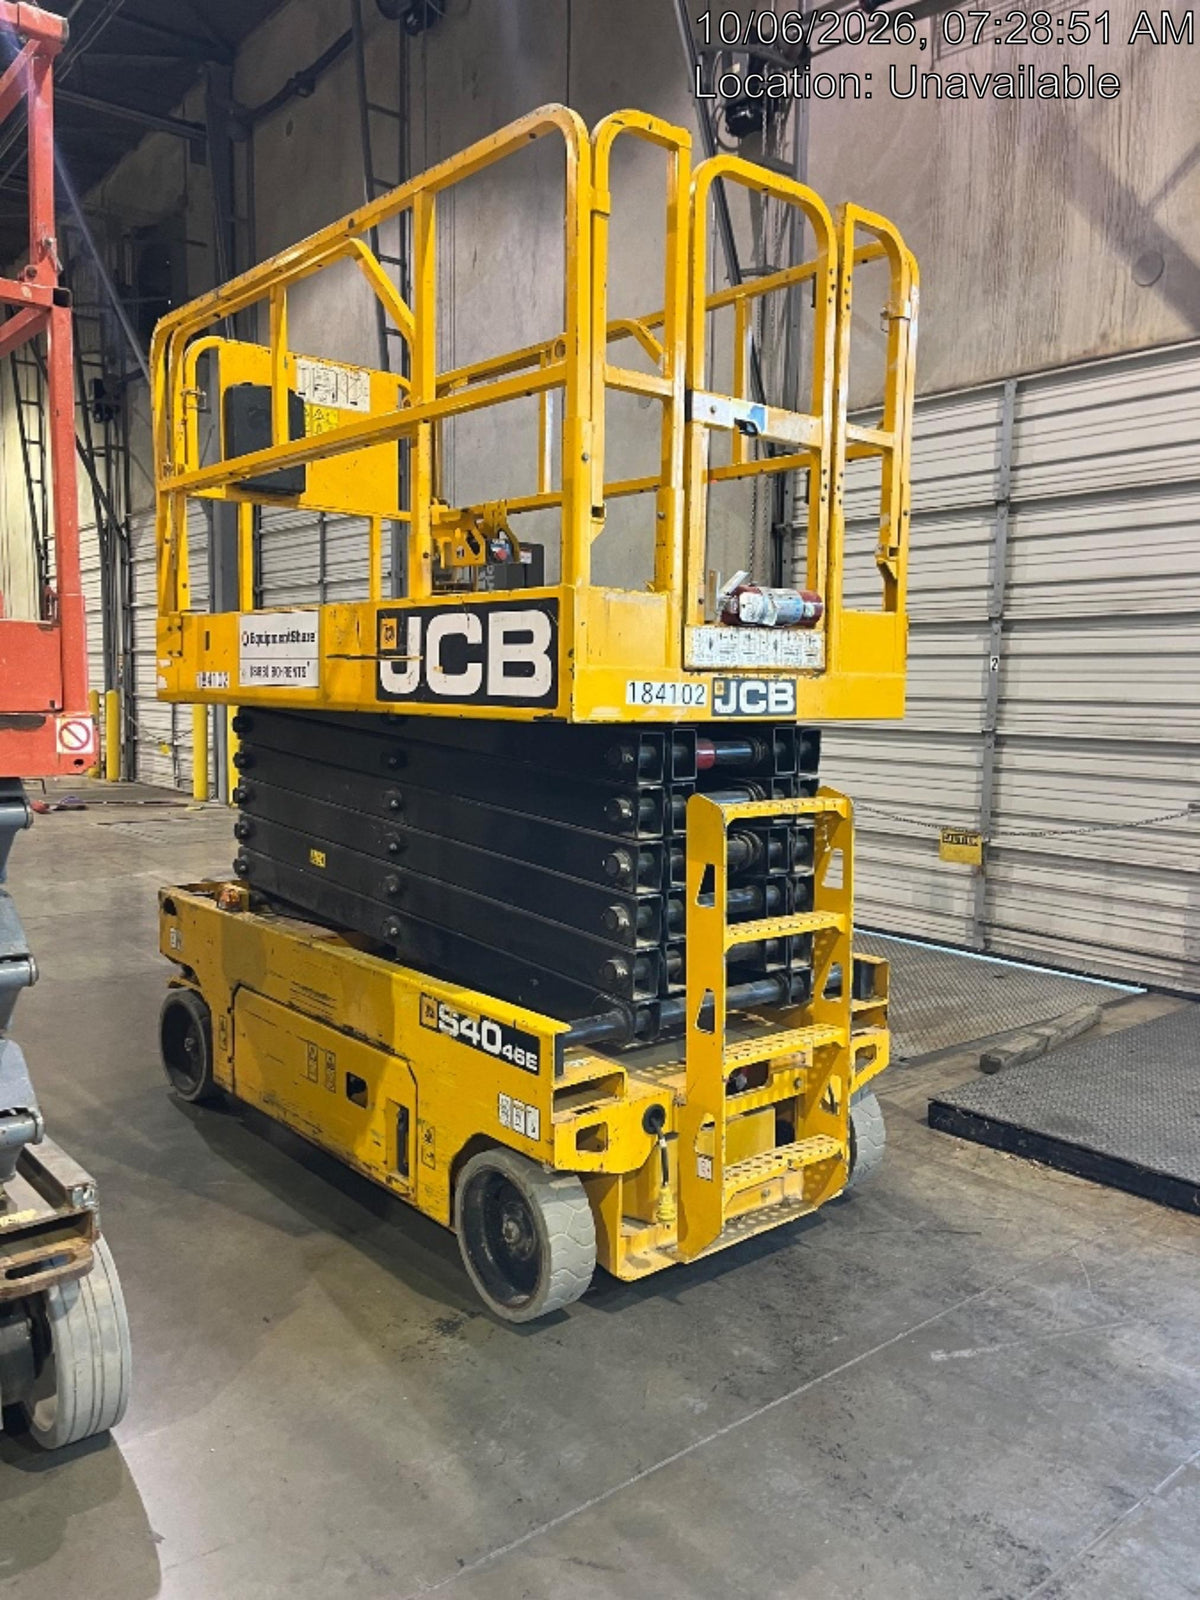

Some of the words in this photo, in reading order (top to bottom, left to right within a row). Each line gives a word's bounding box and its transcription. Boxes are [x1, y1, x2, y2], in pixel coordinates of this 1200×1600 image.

[380, 610, 552, 697] JCB
[629, 682, 706, 705] 184102
[714, 680, 795, 714] JCB
